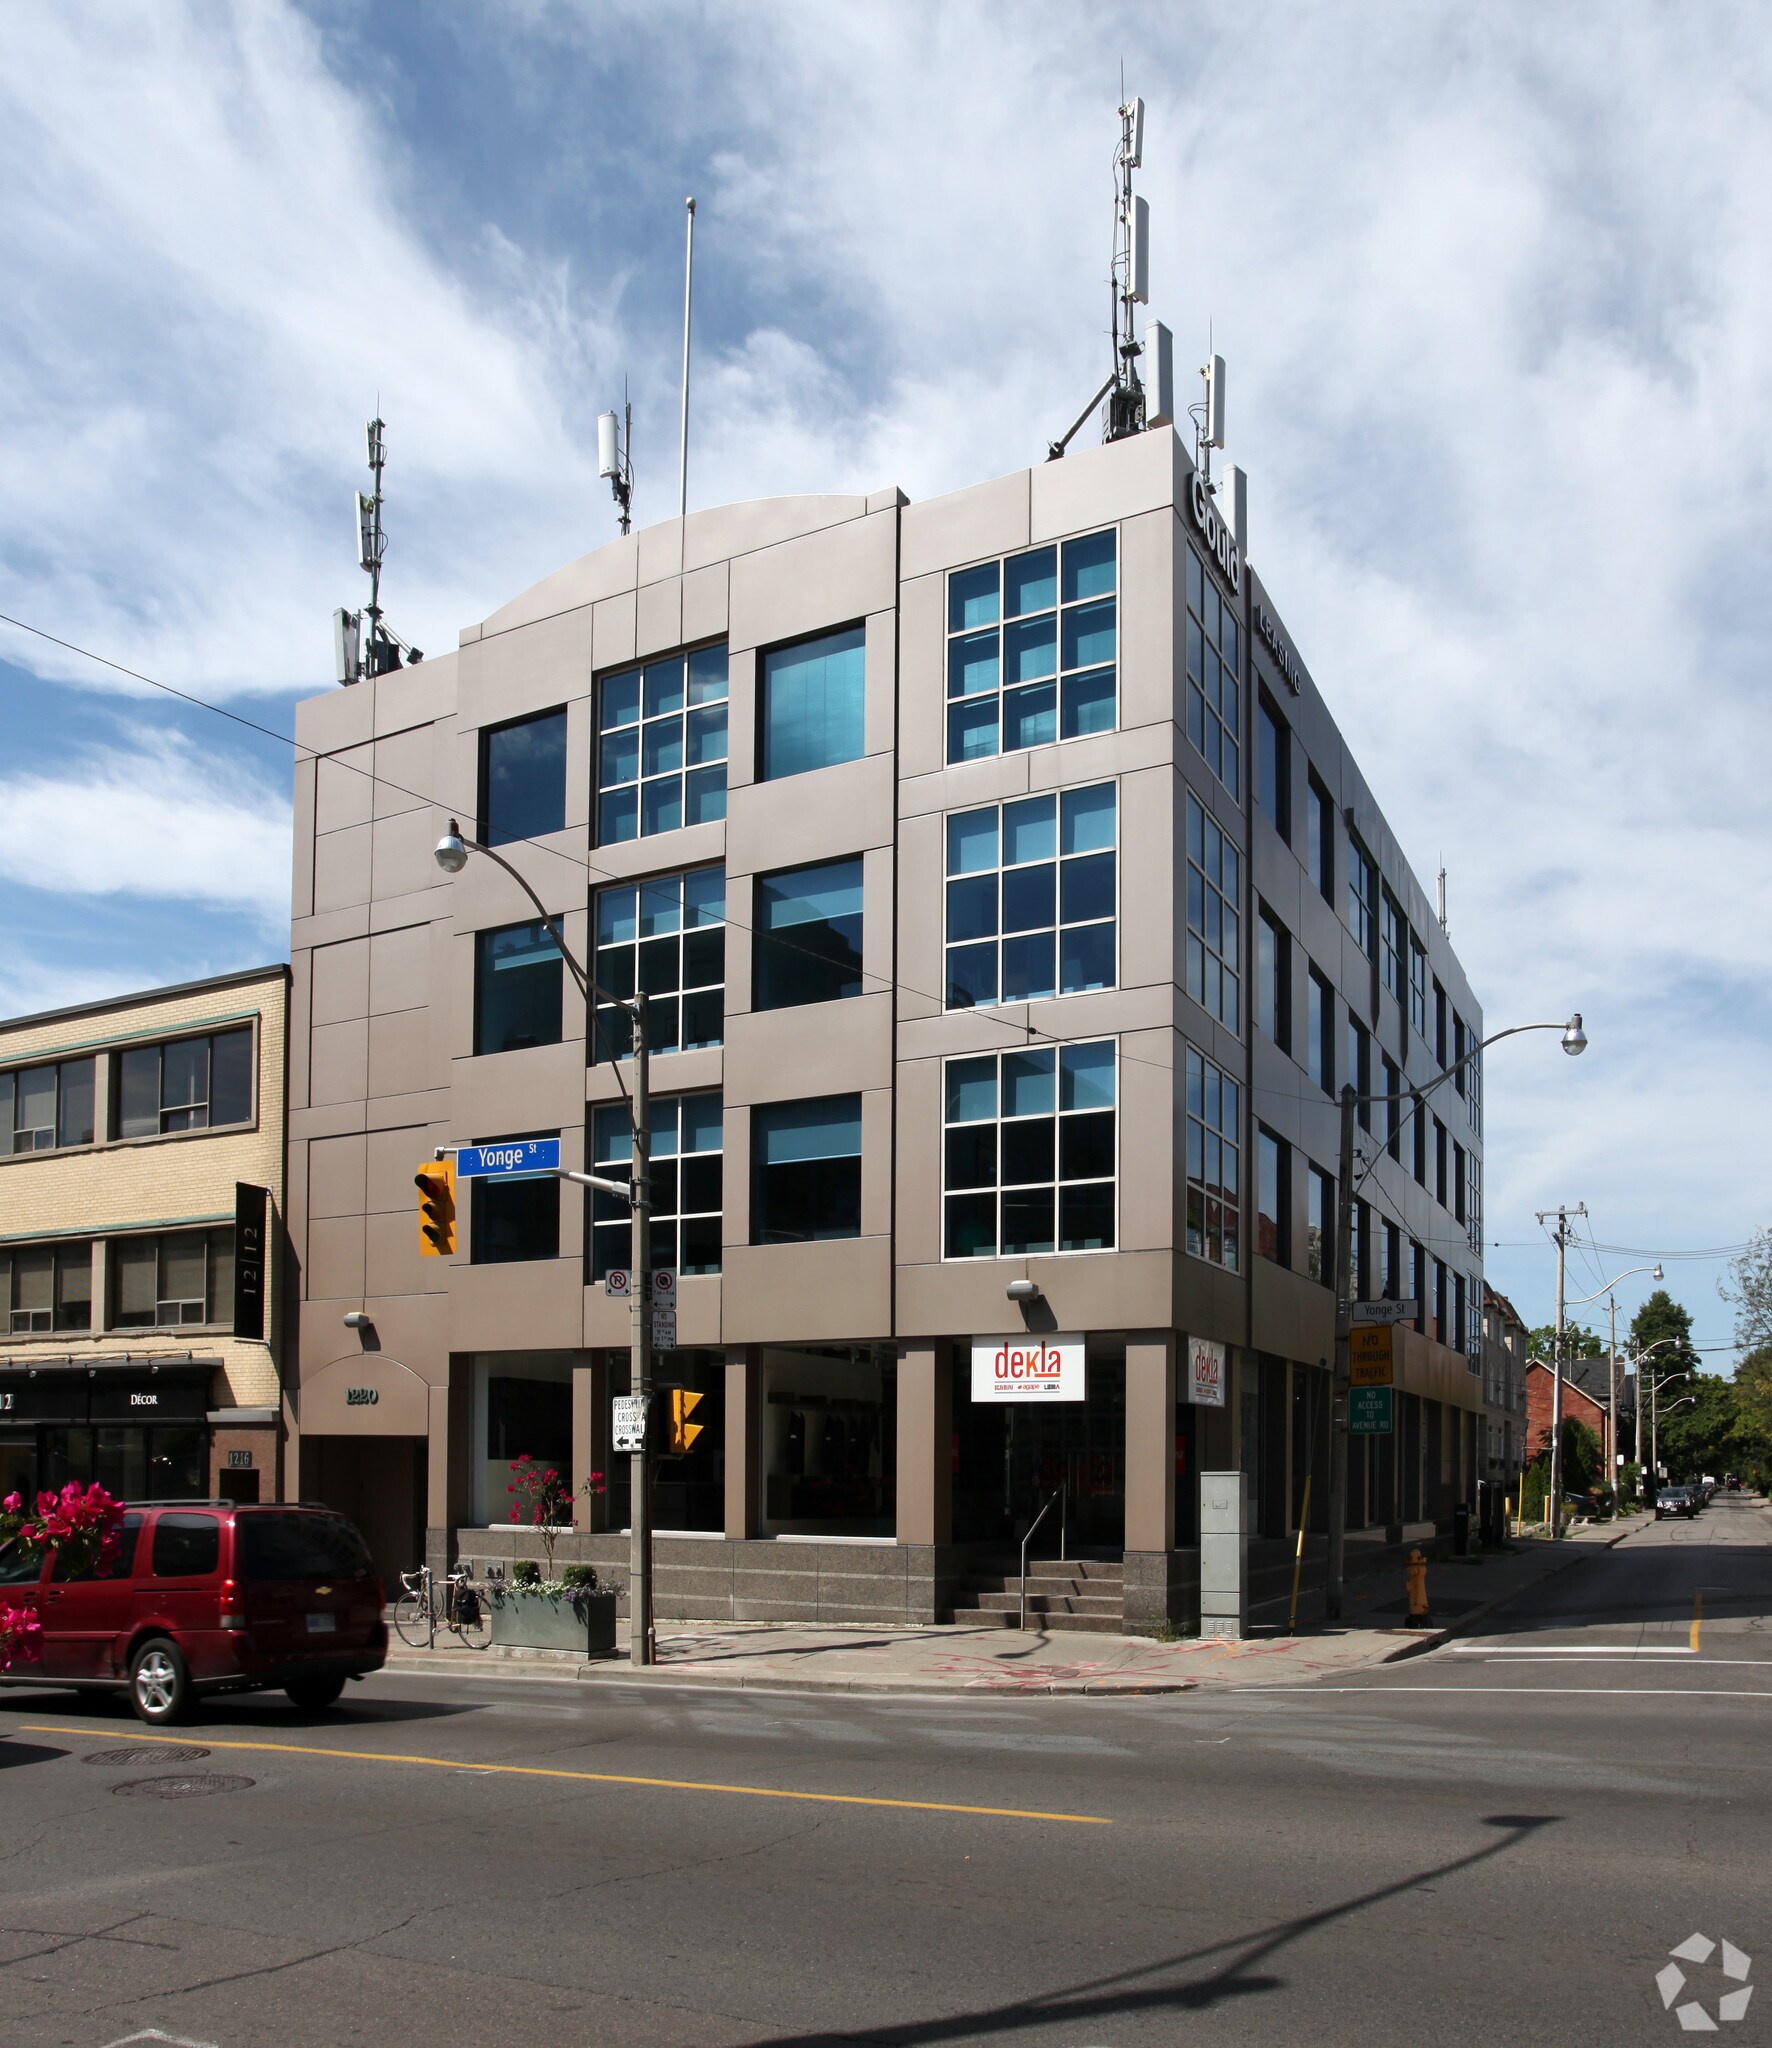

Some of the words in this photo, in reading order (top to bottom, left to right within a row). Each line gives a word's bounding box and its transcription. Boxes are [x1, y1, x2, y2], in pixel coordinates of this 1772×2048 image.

[1192, 470, 1240, 596] Gould
[478, 1147, 523, 1170] Yonge
[529, 1143, 537, 1154] St
[661, 1312, 668, 1320] NO
[1365, 1305, 1392, 1317] Yonge
[1396, 1303, 1405, 1314] St
[653, 1320, 675, 1328] STANDING
[1362, 1335, 1379, 1346] NO
[994, 1341, 1061, 1379] dekla
[1353, 1350, 1389, 1362] THROUGH
[1195, 1345, 1218, 1383] dekla
[1355, 1366, 1386, 1378] TRAFFIC
[130, 1392, 158, 1406] DÉCOR
[346, 1388, 378, 1404] 1220
[1366, 1391, 1376, 1399] NO
[1357, 1401, 1383, 1409] ACCESS
[618, 1411, 637, 1422] CROSS
[1366, 1411, 1375, 1419] TO
[615, 1423, 645, 1435] CROSSWAL
[1352, 1421, 1376, 1430] AVENUE
[1380, 1420, 1389, 1429] RD
[230, 1452, 250, 1465] 1216
